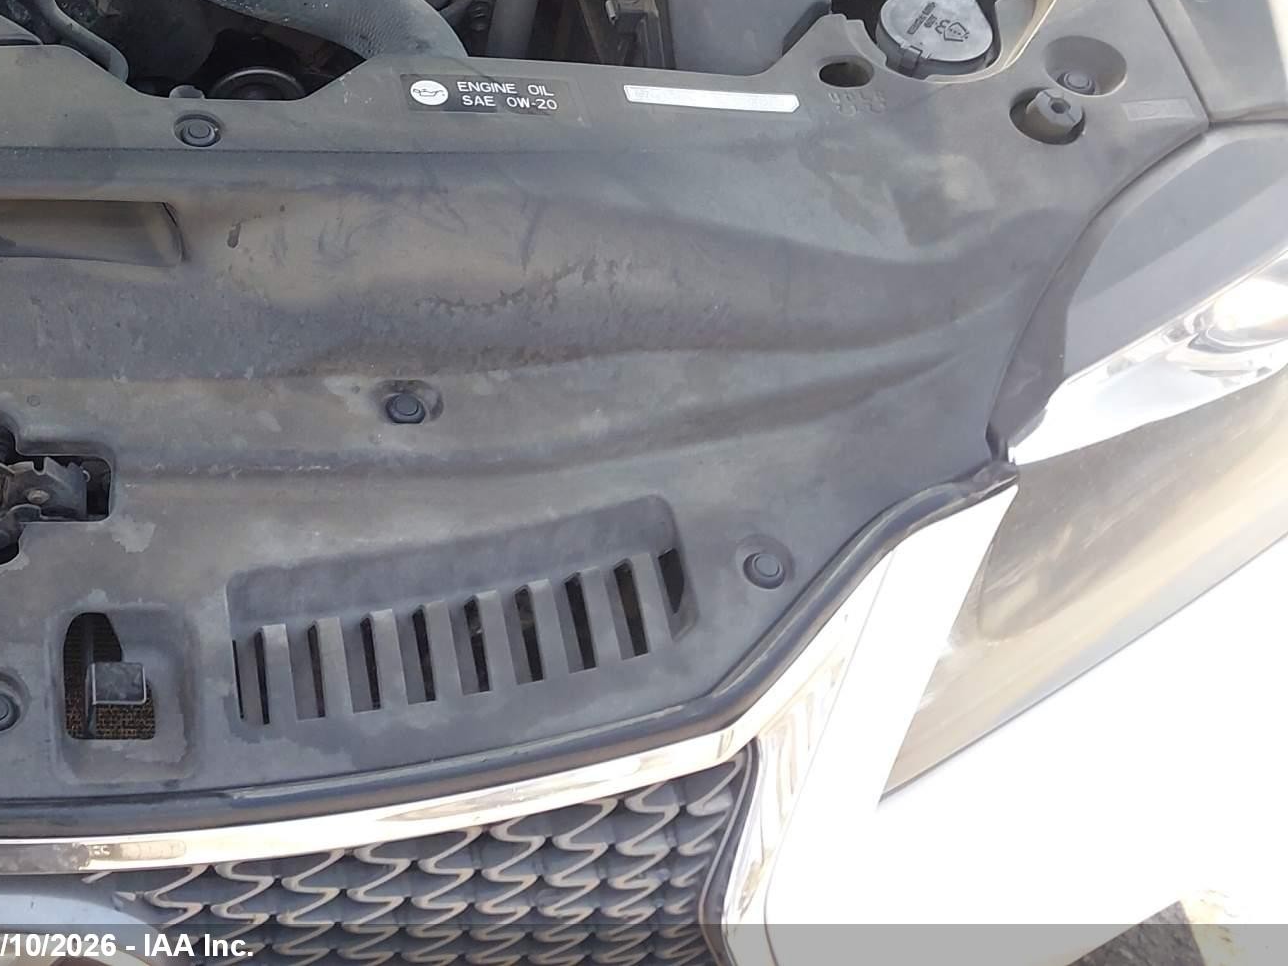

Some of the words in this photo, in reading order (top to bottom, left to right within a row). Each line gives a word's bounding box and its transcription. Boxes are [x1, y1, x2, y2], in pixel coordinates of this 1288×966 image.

[456, 81, 518, 94] ENGINE
[527, 84, 555, 97] OIL
[462, 95, 497, 107] SAE
[506, 96, 558, 110] 0W-20
